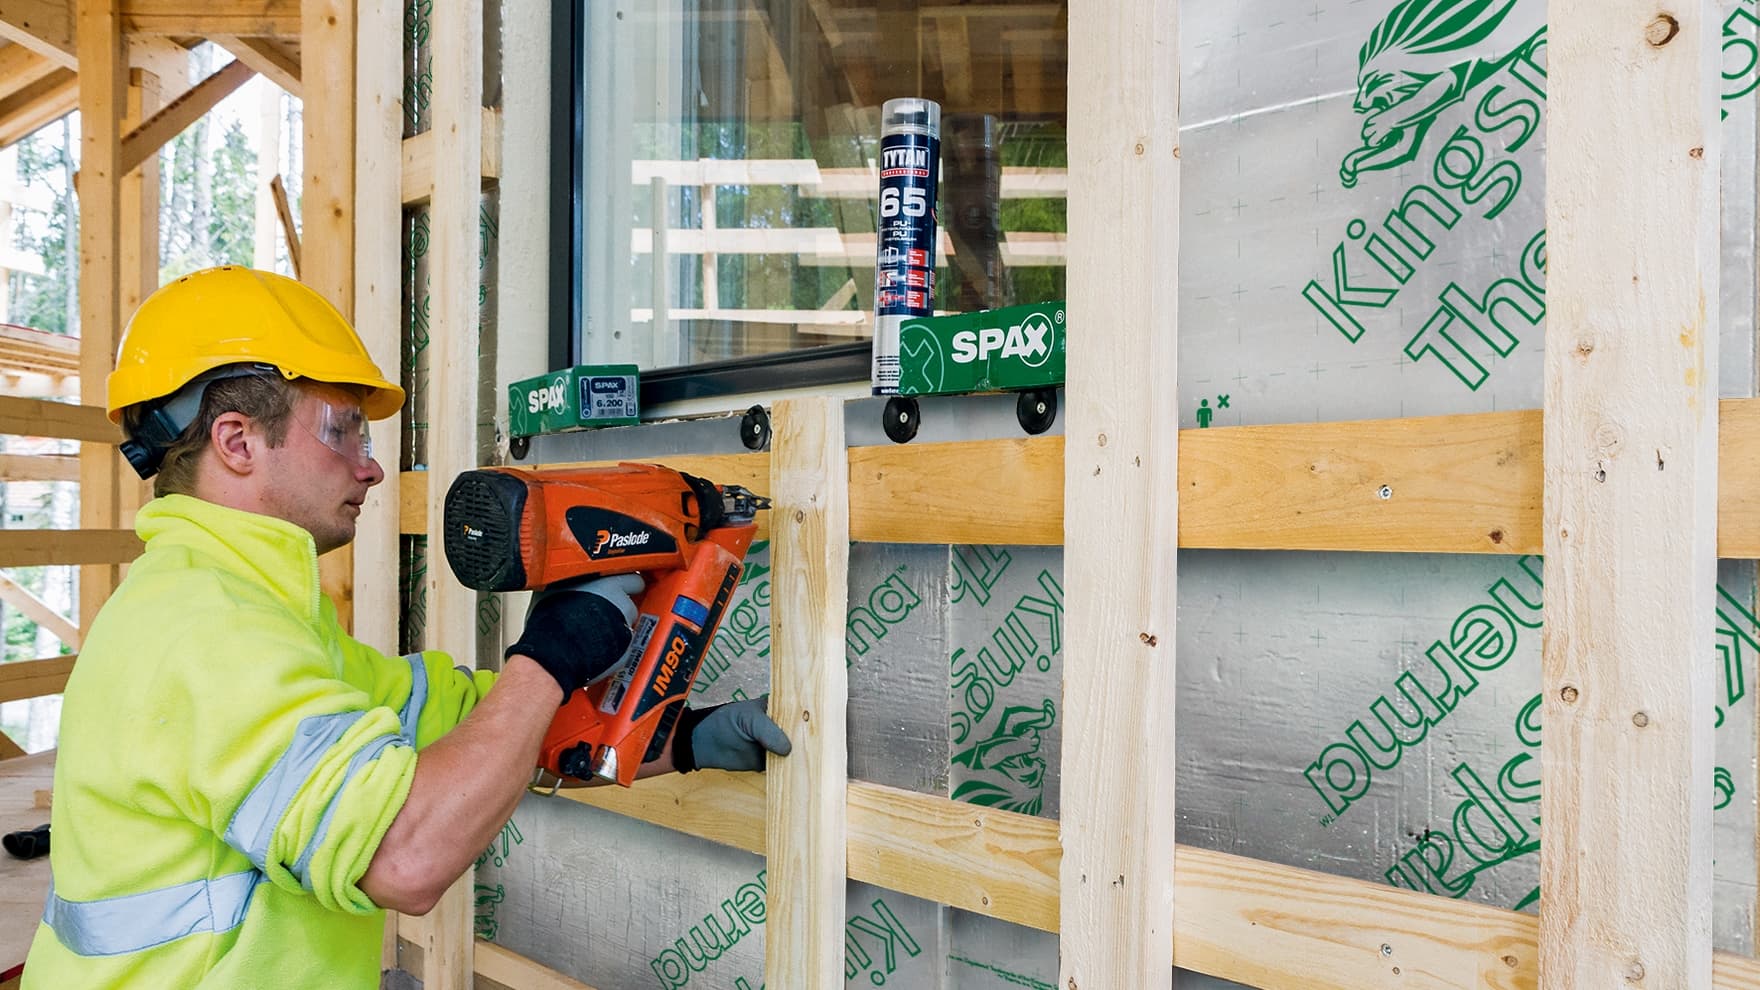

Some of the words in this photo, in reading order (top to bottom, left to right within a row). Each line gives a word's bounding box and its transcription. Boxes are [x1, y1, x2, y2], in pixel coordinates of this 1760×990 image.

[883, 149, 926, 169] TYTAN
[881, 187, 926, 217] 65
[951, 315, 1054, 367] SPAX
[528, 379, 566, 414] SPAX
[609, 530, 650, 548] Paslode
